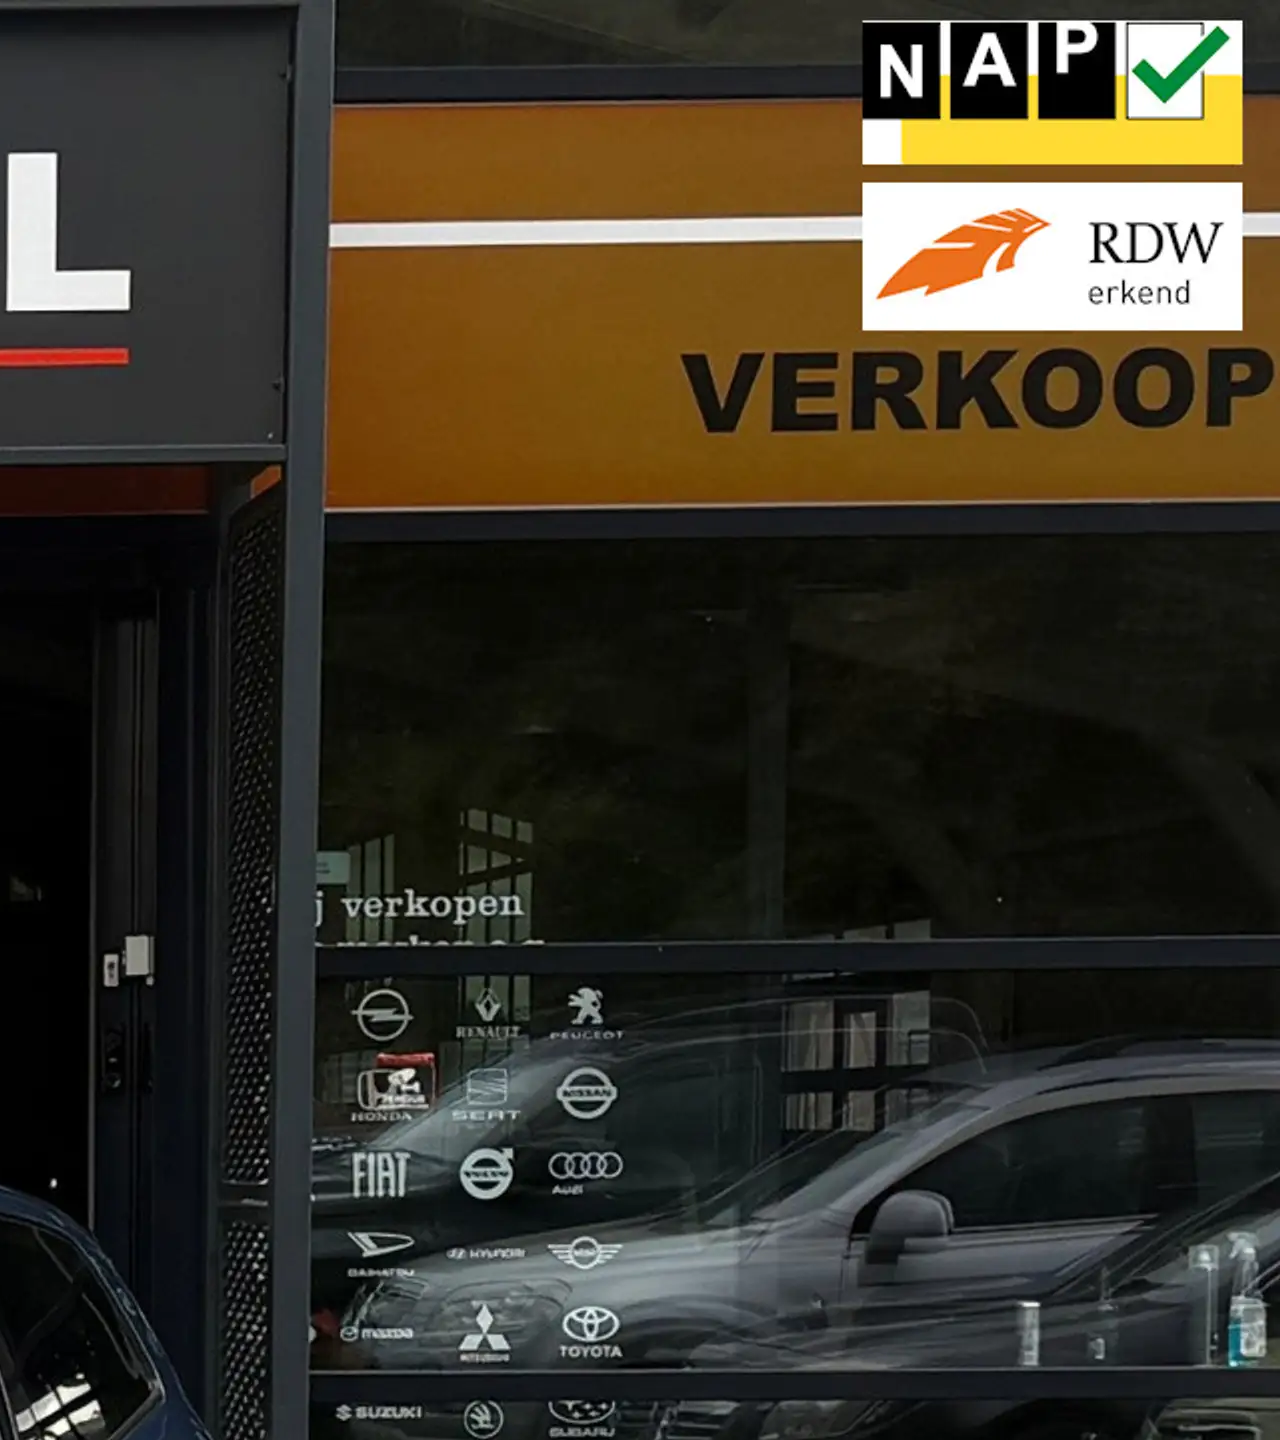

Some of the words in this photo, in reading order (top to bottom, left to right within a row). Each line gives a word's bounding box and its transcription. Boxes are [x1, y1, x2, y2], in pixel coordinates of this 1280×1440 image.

[682, 347, 1275, 433] VERKOOP
[341, 888, 525, 925] verkopen
[455, 1025, 522, 1039] RENAULT
[549, 1030, 625, 1040] PEUGEOT
[562, 1088, 612, 1098] NISSAN
[350, 1111, 413, 1122] HONDA
[451, 1109, 522, 1122] SEAT
[351, 1151, 412, 1198] FIAT
[559, 1345, 624, 1358] TOYOTA
[355, 1405, 422, 1420] SUZUKI
[548, 1426, 616, 1438] SUBARU
